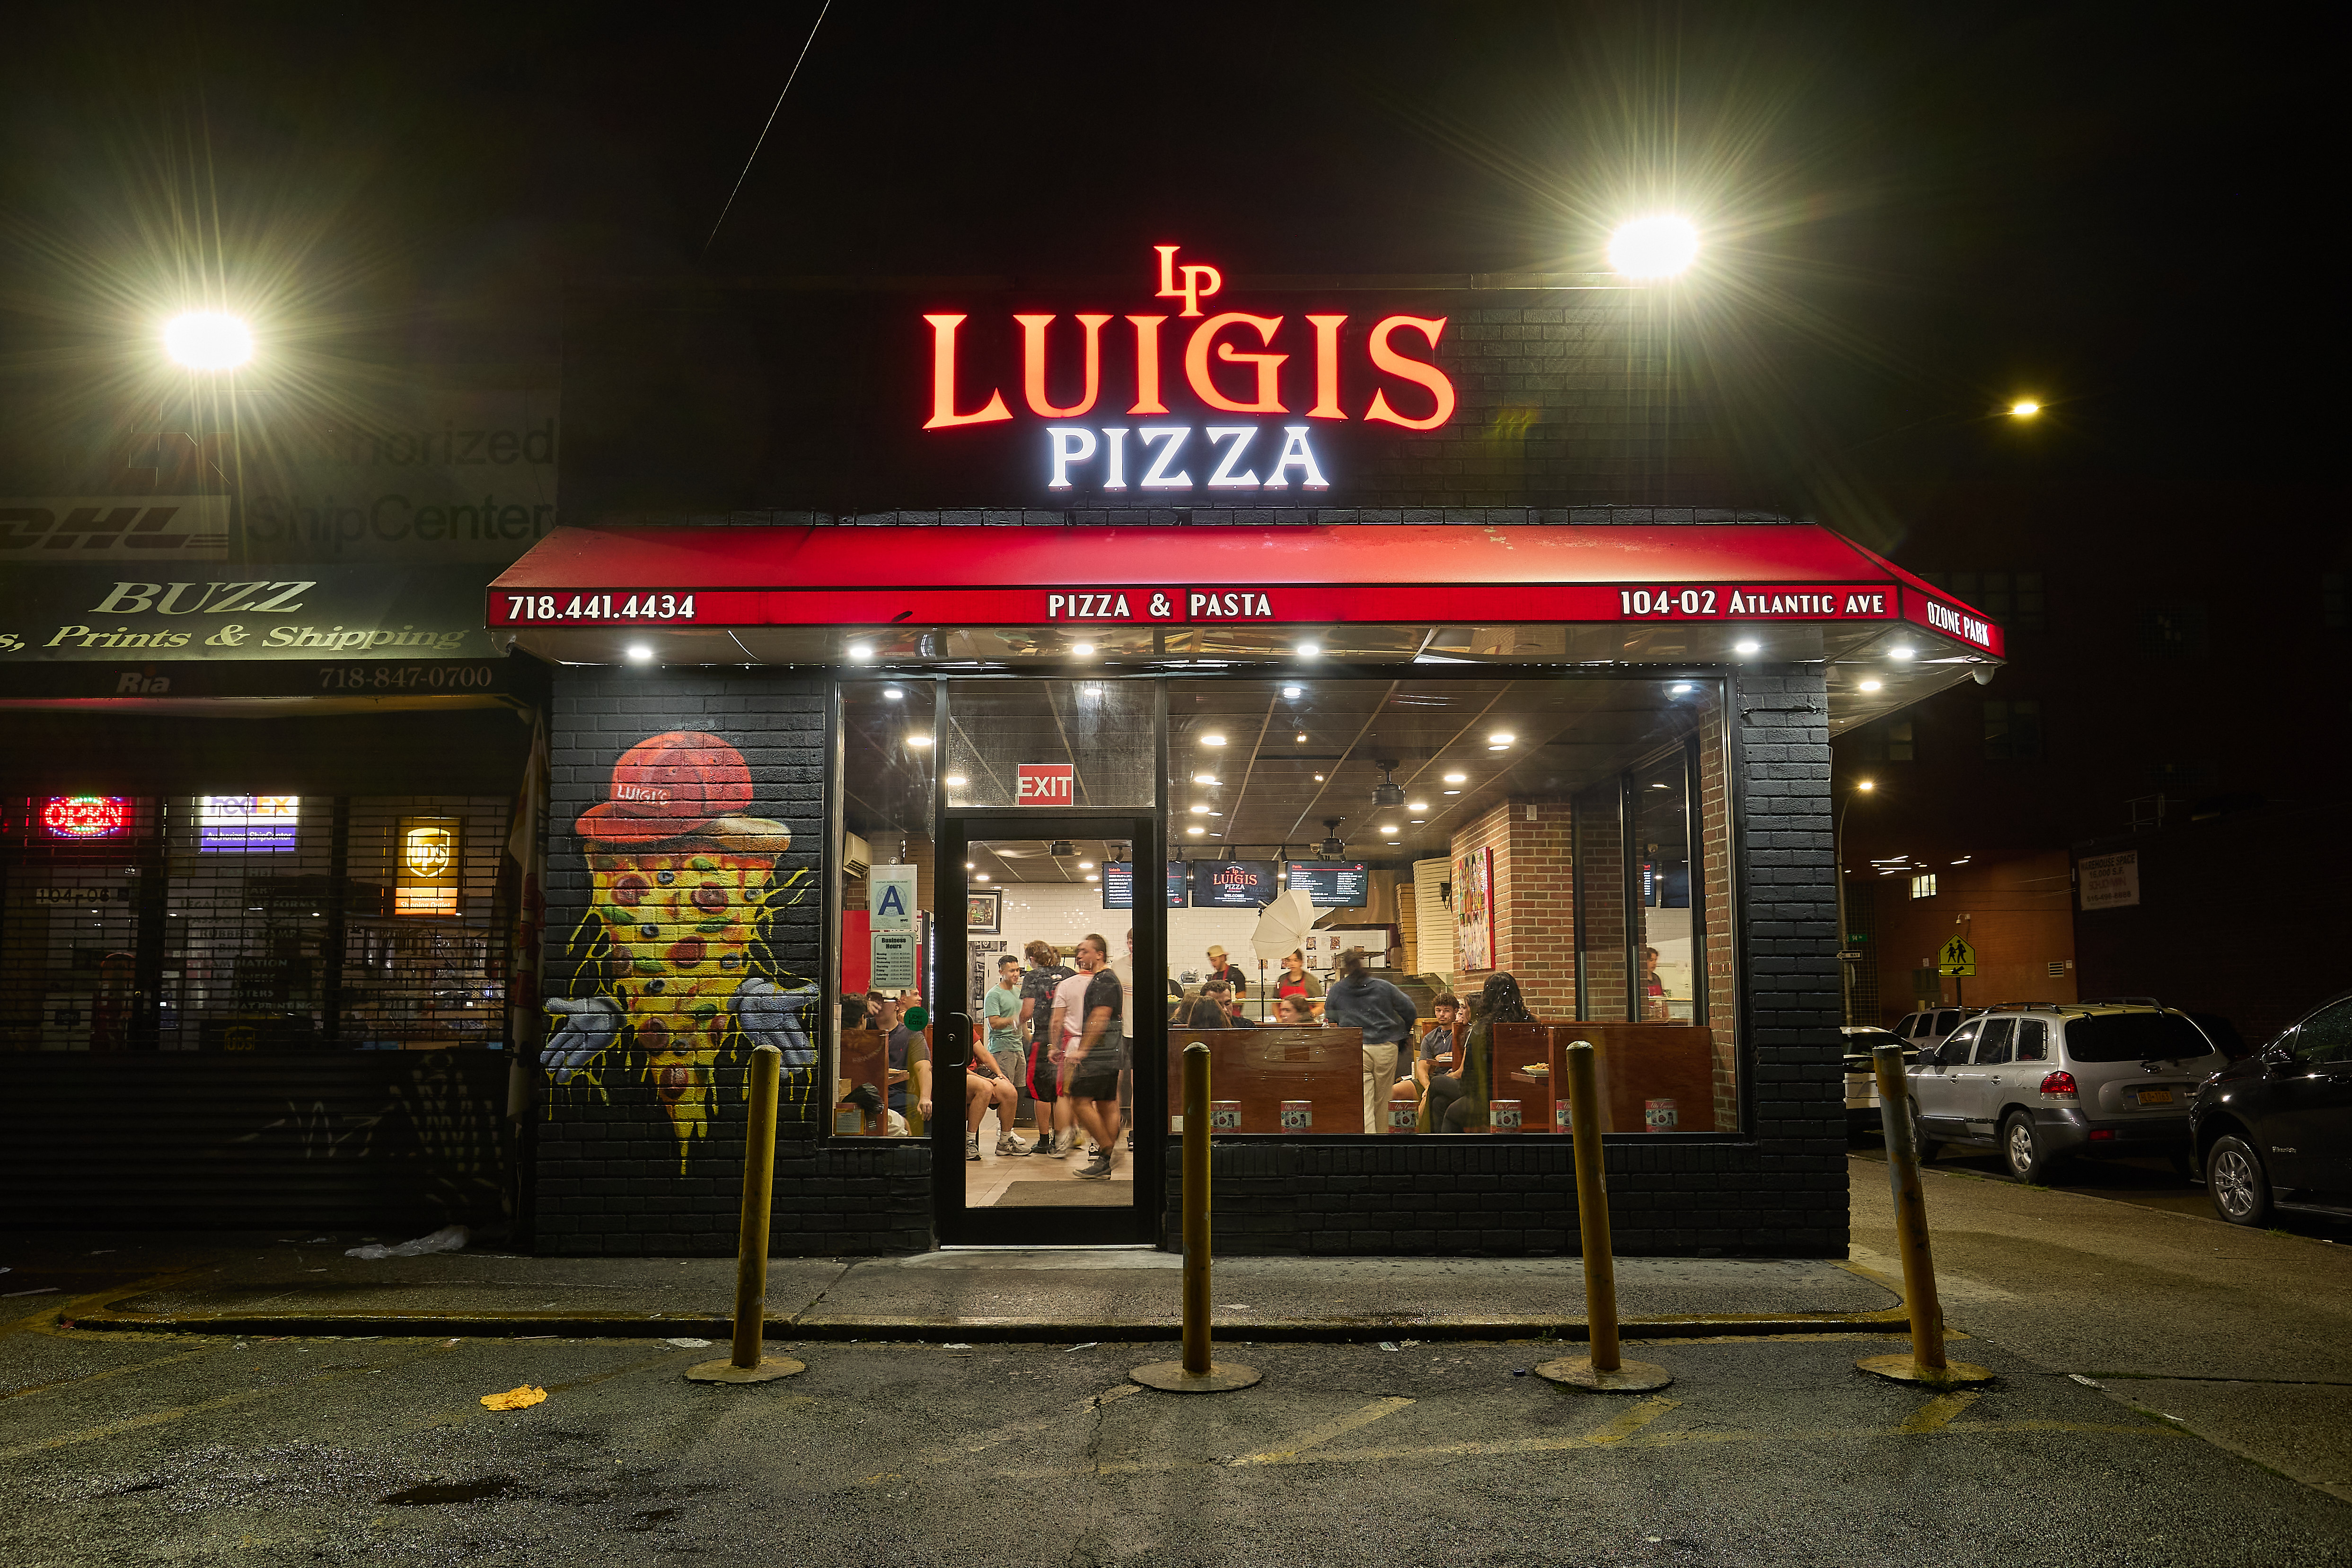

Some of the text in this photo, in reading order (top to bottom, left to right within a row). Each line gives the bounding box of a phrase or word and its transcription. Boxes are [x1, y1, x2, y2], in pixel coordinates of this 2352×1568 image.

[1154, 246, 1221, 317] LP
[922, 312, 1455, 430] LUIGIS
[1046, 426, 1330, 491] PIZZA
[88, 581, 317, 615] BUZZ
[508, 595, 695, 620] 718.441.4434
[1048, 593, 1273, 617] PIZZA & PASTA
[1621, 590, 1717, 615] 104-02
[1845, 594, 1884, 614] AVE
[1927, 600, 1990, 647] OZONE PARK
[42, 625, 192, 648] Prints
[205, 624, 250, 647] &
[262, 625, 470, 651] Shipping
[116, 665, 171, 694] Ria
[319, 666, 492, 688] 718-847-0700
[1018, 776, 1072, 797] EXIT
[45, 803, 122, 826] OPEN
[2080, 854, 2136, 871] WAREHOUSE SPACE
[1213, 874, 1258, 885] LUIGIS
[877, 885, 905, 915] A
